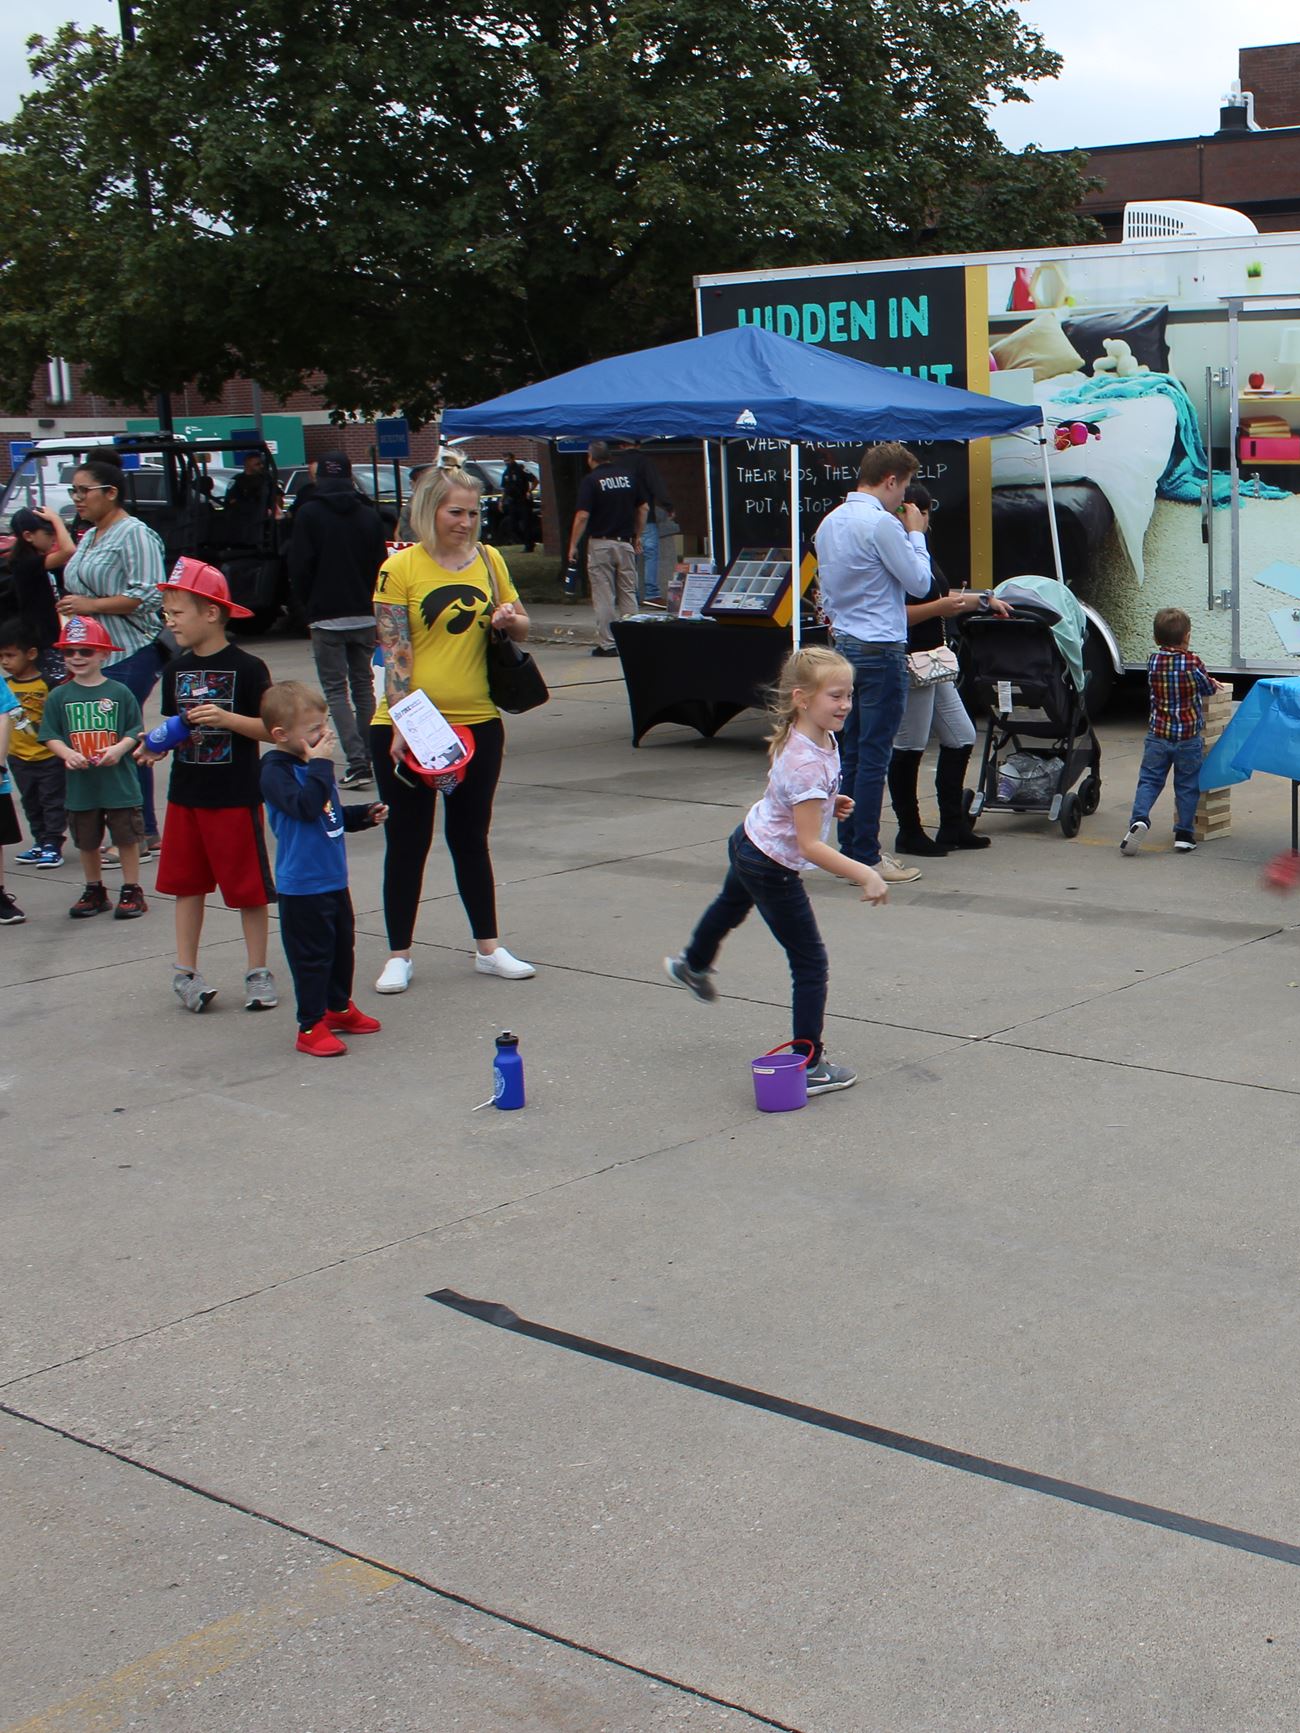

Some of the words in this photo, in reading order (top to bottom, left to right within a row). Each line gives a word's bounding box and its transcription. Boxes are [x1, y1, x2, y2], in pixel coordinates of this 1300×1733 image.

[888, 295, 929, 339] IN
[599, 476, 631, 491] POLICE
[783, 468, 817, 485] KDS,
[745, 497, 773, 513] PUT
[780, 500, 790, 515] A
[65, 700, 119, 732] IRISH
